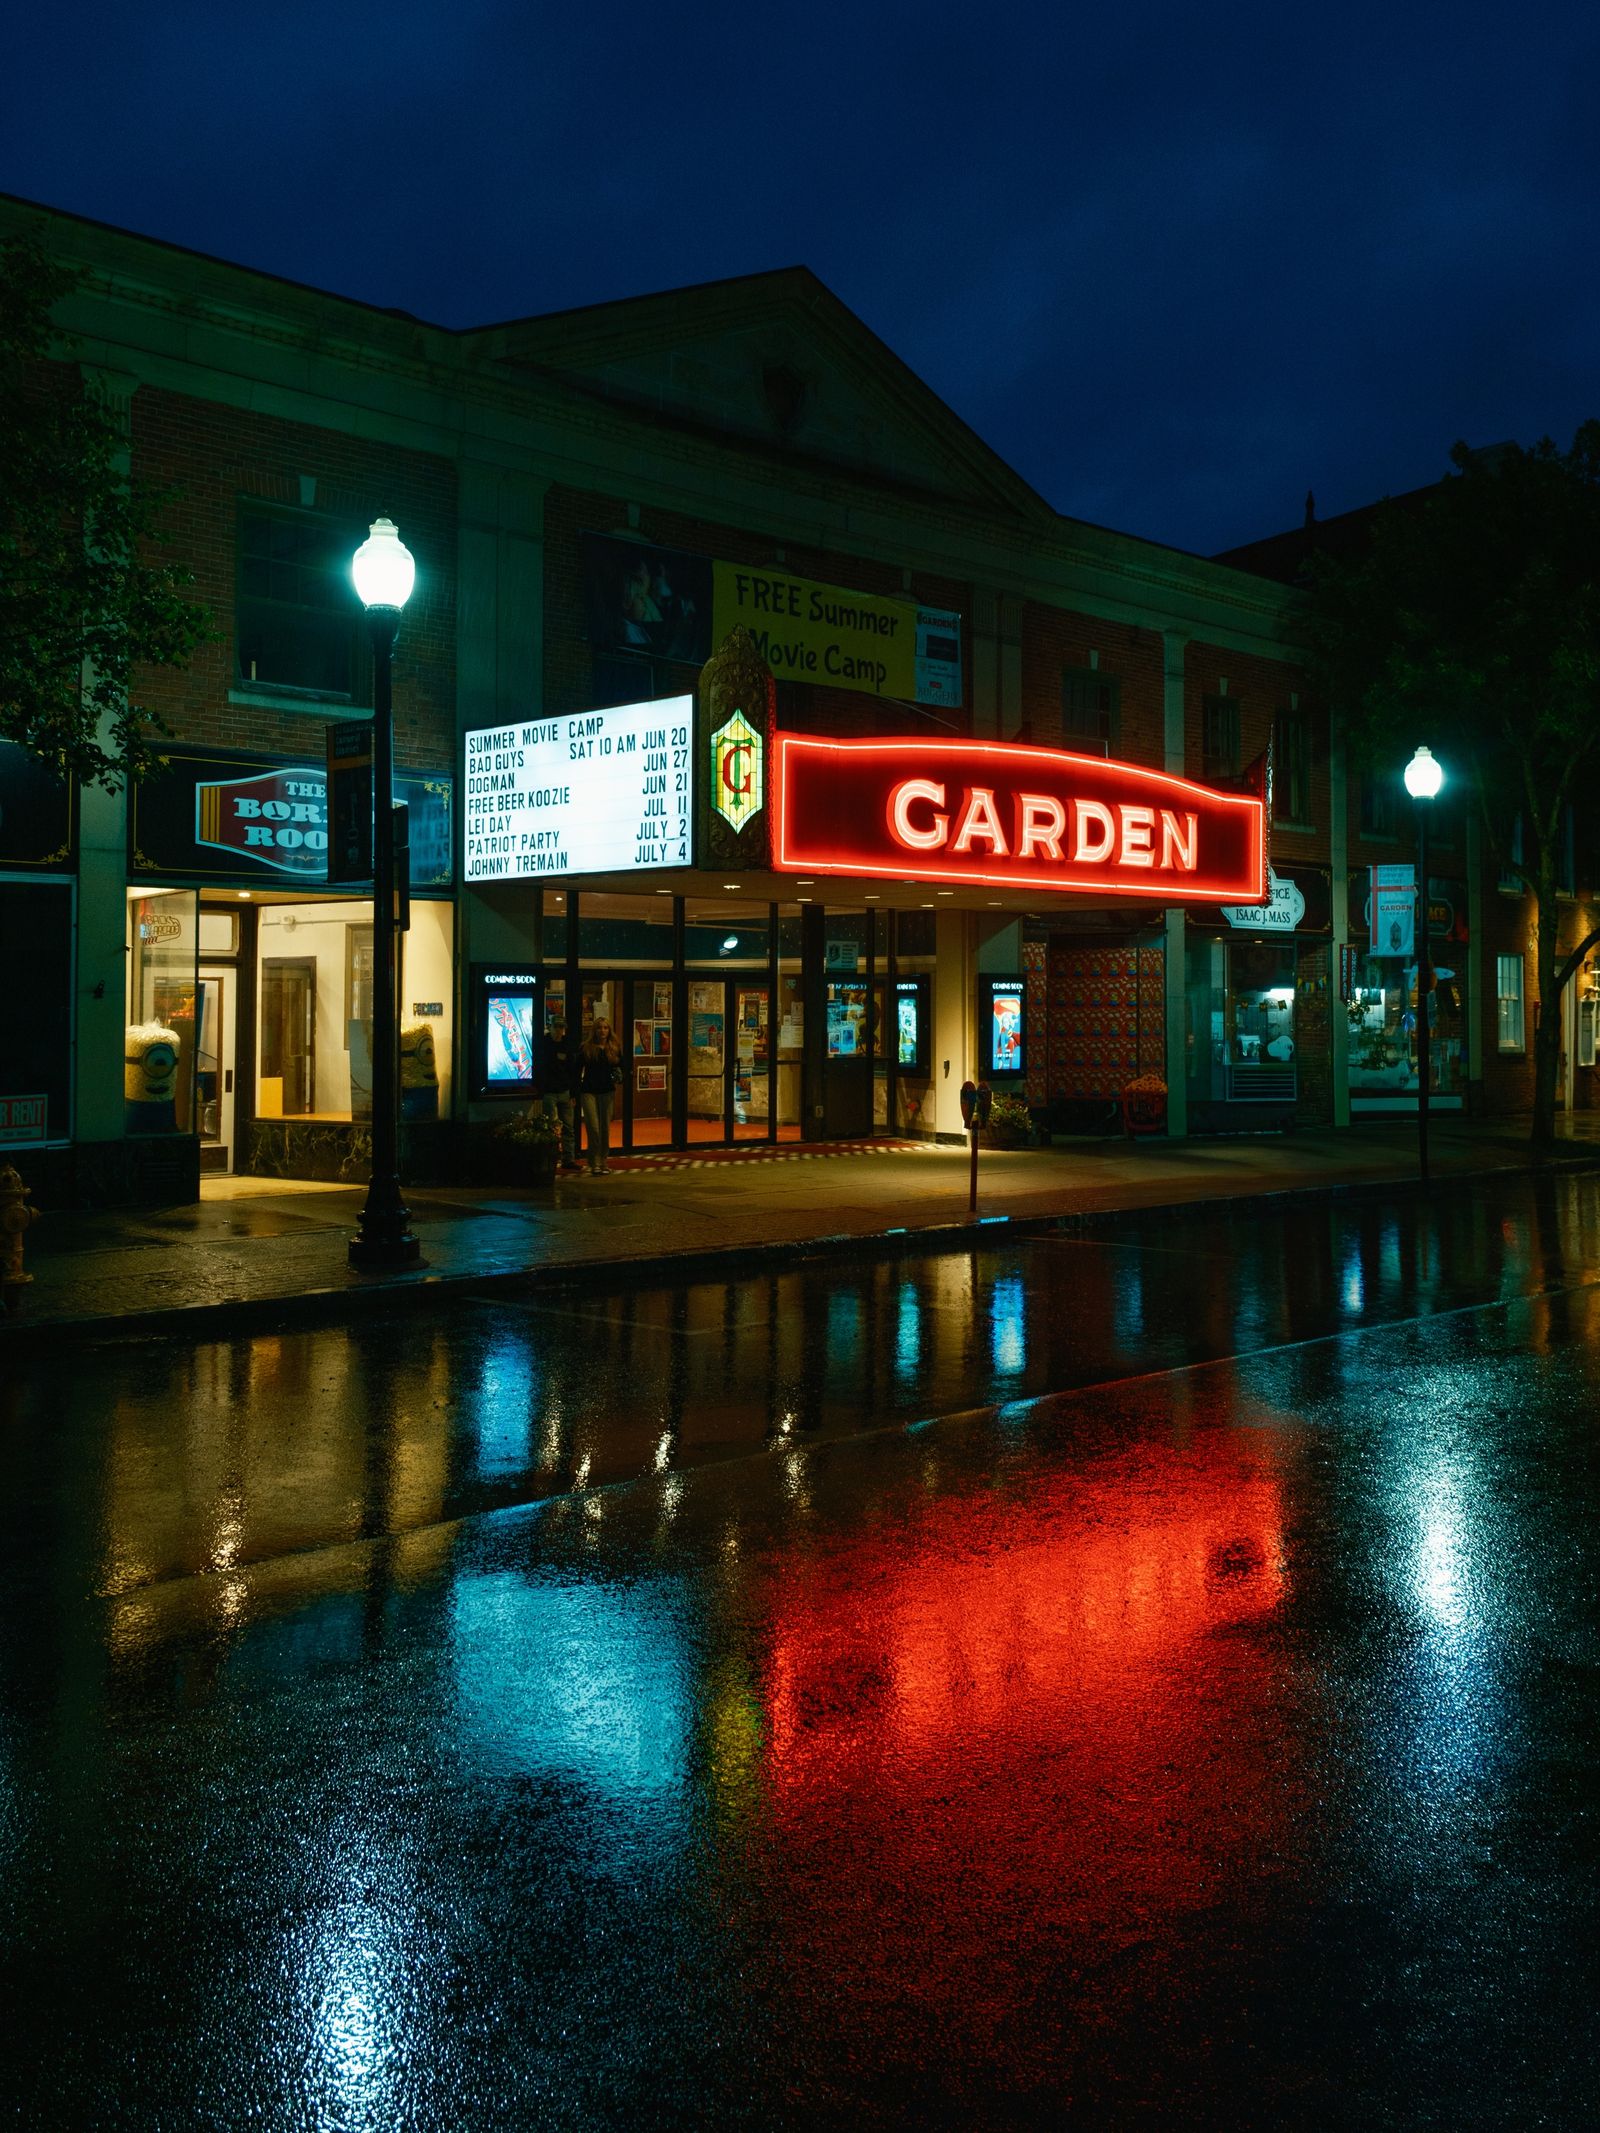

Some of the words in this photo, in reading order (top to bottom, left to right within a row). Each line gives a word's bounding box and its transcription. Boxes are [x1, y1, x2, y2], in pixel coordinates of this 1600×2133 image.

[735, 574, 802, 618] FREE
[809, 591, 898, 637] Summer
[748, 628, 817, 671] Movie
[824, 644, 887, 693] Camp
[469, 731, 515, 754] SUMMER
[523, 723, 558, 746] MOVIE
[569, 717, 604, 738] CAMP
[469, 755, 491, 774] BAD
[495, 750, 524, 771] GUYS
[570, 740, 593, 760] SAT
[617, 733, 636, 754] AM
[642, 729, 666, 750] JUN
[671, 727, 687, 746] 20
[285, 781, 327, 798] THE
[469, 772, 515, 794] DOGMAN
[643, 752, 667, 772] JUN
[673, 749, 688, 768] 27
[233, 797, 328, 824] BOR
[468, 796, 494, 815] FREE
[498, 792, 525, 812] BEER
[528, 787, 571, 809] KOOZIE
[642, 774, 666, 795] JUN
[675, 773, 688, 792] 21
[468, 818, 485, 835] LEI
[490, 814, 512, 833] DAY
[644, 797, 667, 817] JUL
[886, 778, 1198, 871] GARDEN
[243, 825, 328, 850] ROO
[468, 835, 517, 856] PATRIOT
[521, 830, 560, 851] PARTY
[636, 820, 668, 840] JULY
[679, 818, 687, 837] 2
[468, 856, 510, 876] JOHNNY
[516, 851, 568, 872] TREMAIN
[635, 843, 667, 863] JULY
[678, 842, 686, 860] 4
[1236, 908, 1261, 921] ISAAC
[1268, 910, 1291, 923] MASS
[484, 974, 516, 984] COMING
[516, 974, 536, 984] SOON
